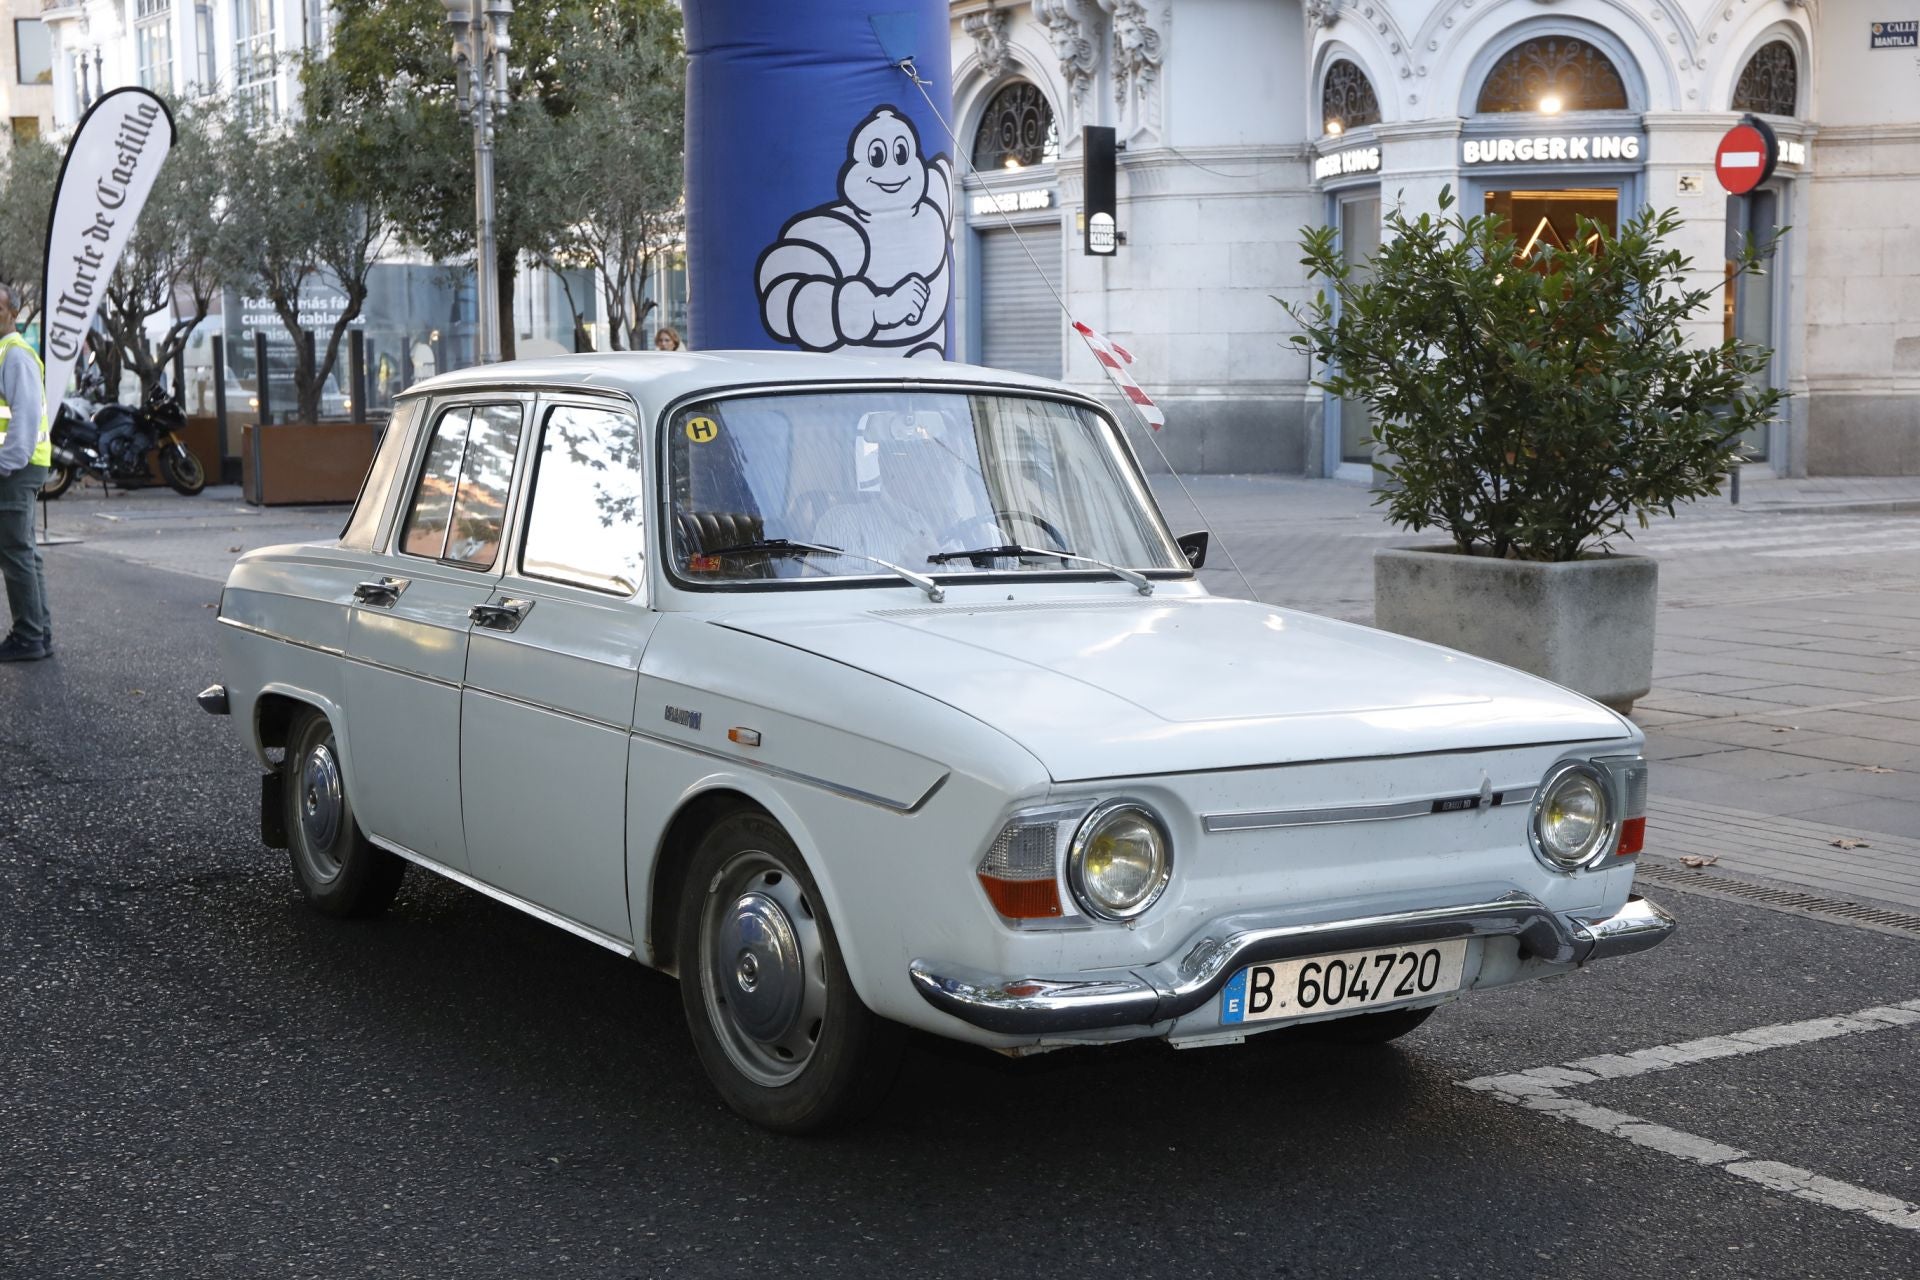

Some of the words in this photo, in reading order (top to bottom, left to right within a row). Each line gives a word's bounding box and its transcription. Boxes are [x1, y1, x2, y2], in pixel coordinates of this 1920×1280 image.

[1887, 22, 1917, 32] CALLE
[1874, 36, 1915, 46] MANTILLA
[96, 102, 160, 210] Castilla
[1342, 147, 1380, 173] KING
[1463, 137, 1568, 163] BURGER
[1570, 136, 1640, 160] KING
[1020, 189, 1050, 210] KING
[82, 211, 115, 243] de
[1090, 232, 1115, 245] KING
[56, 244, 104, 320] Norte
[298, 296, 328, 309] más
[49, 320, 82, 361] El
[242, 328, 255, 341] el
[692, 421, 712, 439] H
[1249, 966, 1275, 1014] B
[1298, 949, 1441, 1009] 604720
[1228, 999, 1239, 1013] E
